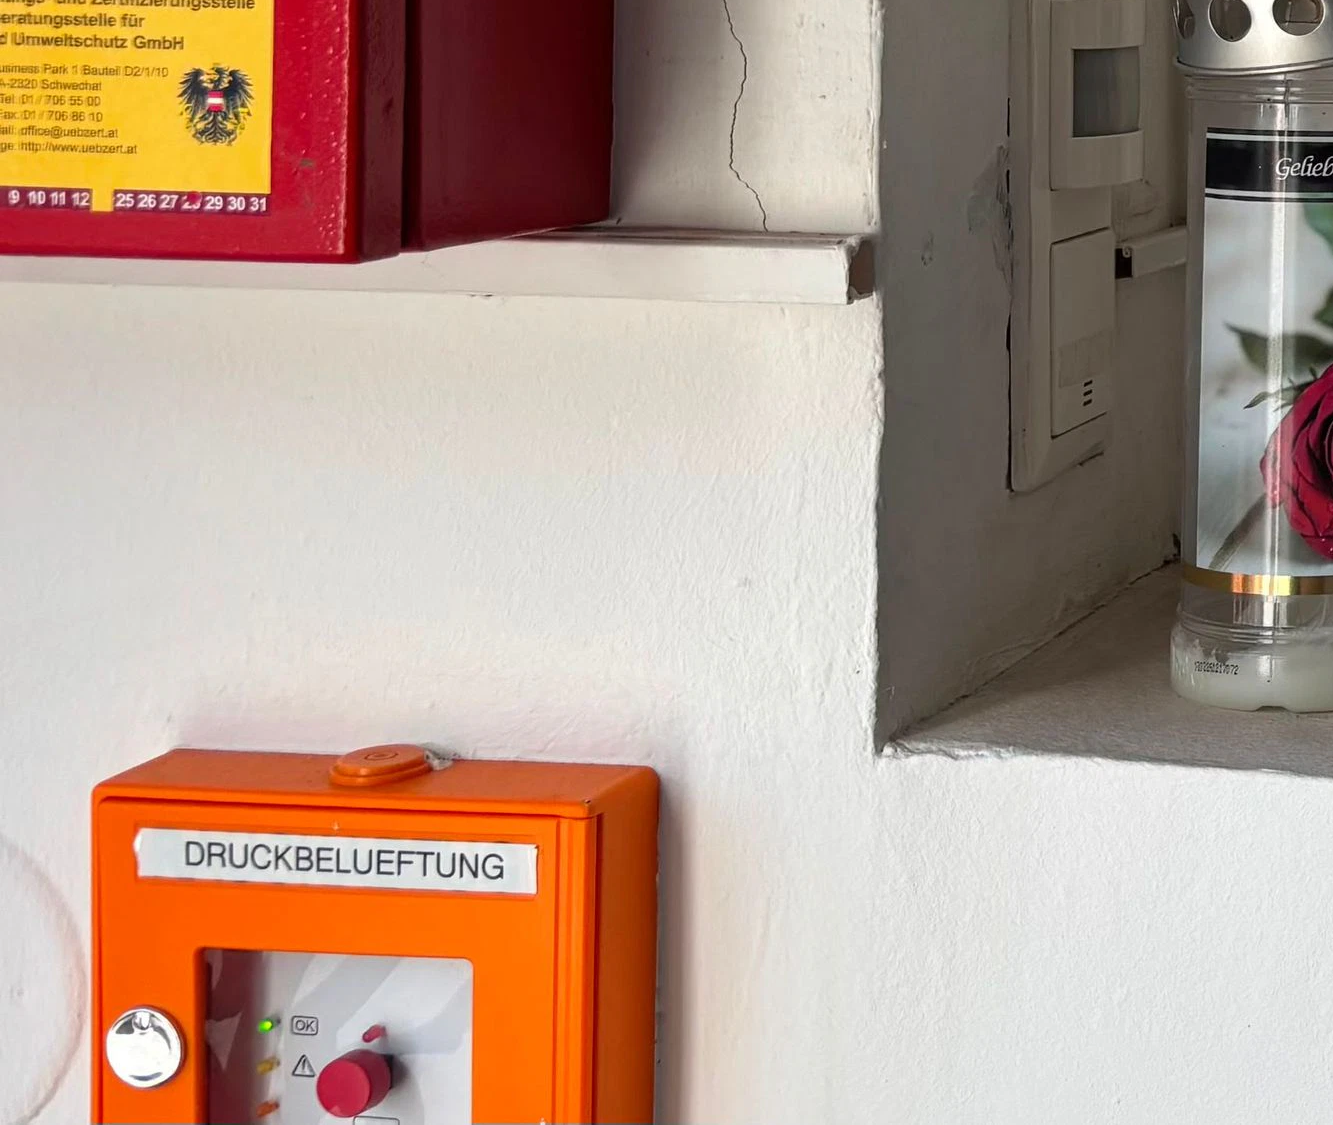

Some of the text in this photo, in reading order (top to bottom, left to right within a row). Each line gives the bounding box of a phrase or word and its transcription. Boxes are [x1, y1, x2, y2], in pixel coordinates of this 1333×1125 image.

[121, 14, 144, 27] für
[11, 33, 184, 50] Umweltschutz GmbH
[44, 64, 68, 74] Park
[28, 191, 45, 204] 10
[51, 192, 65, 205] 11
[72, 193, 89, 206] 12
[116, 193, 266, 211] 25 26 27 29 30 31
[185, 840, 504, 880] DRUCKBELUEFTUNG
[296, 1021, 315, 1032] OK
